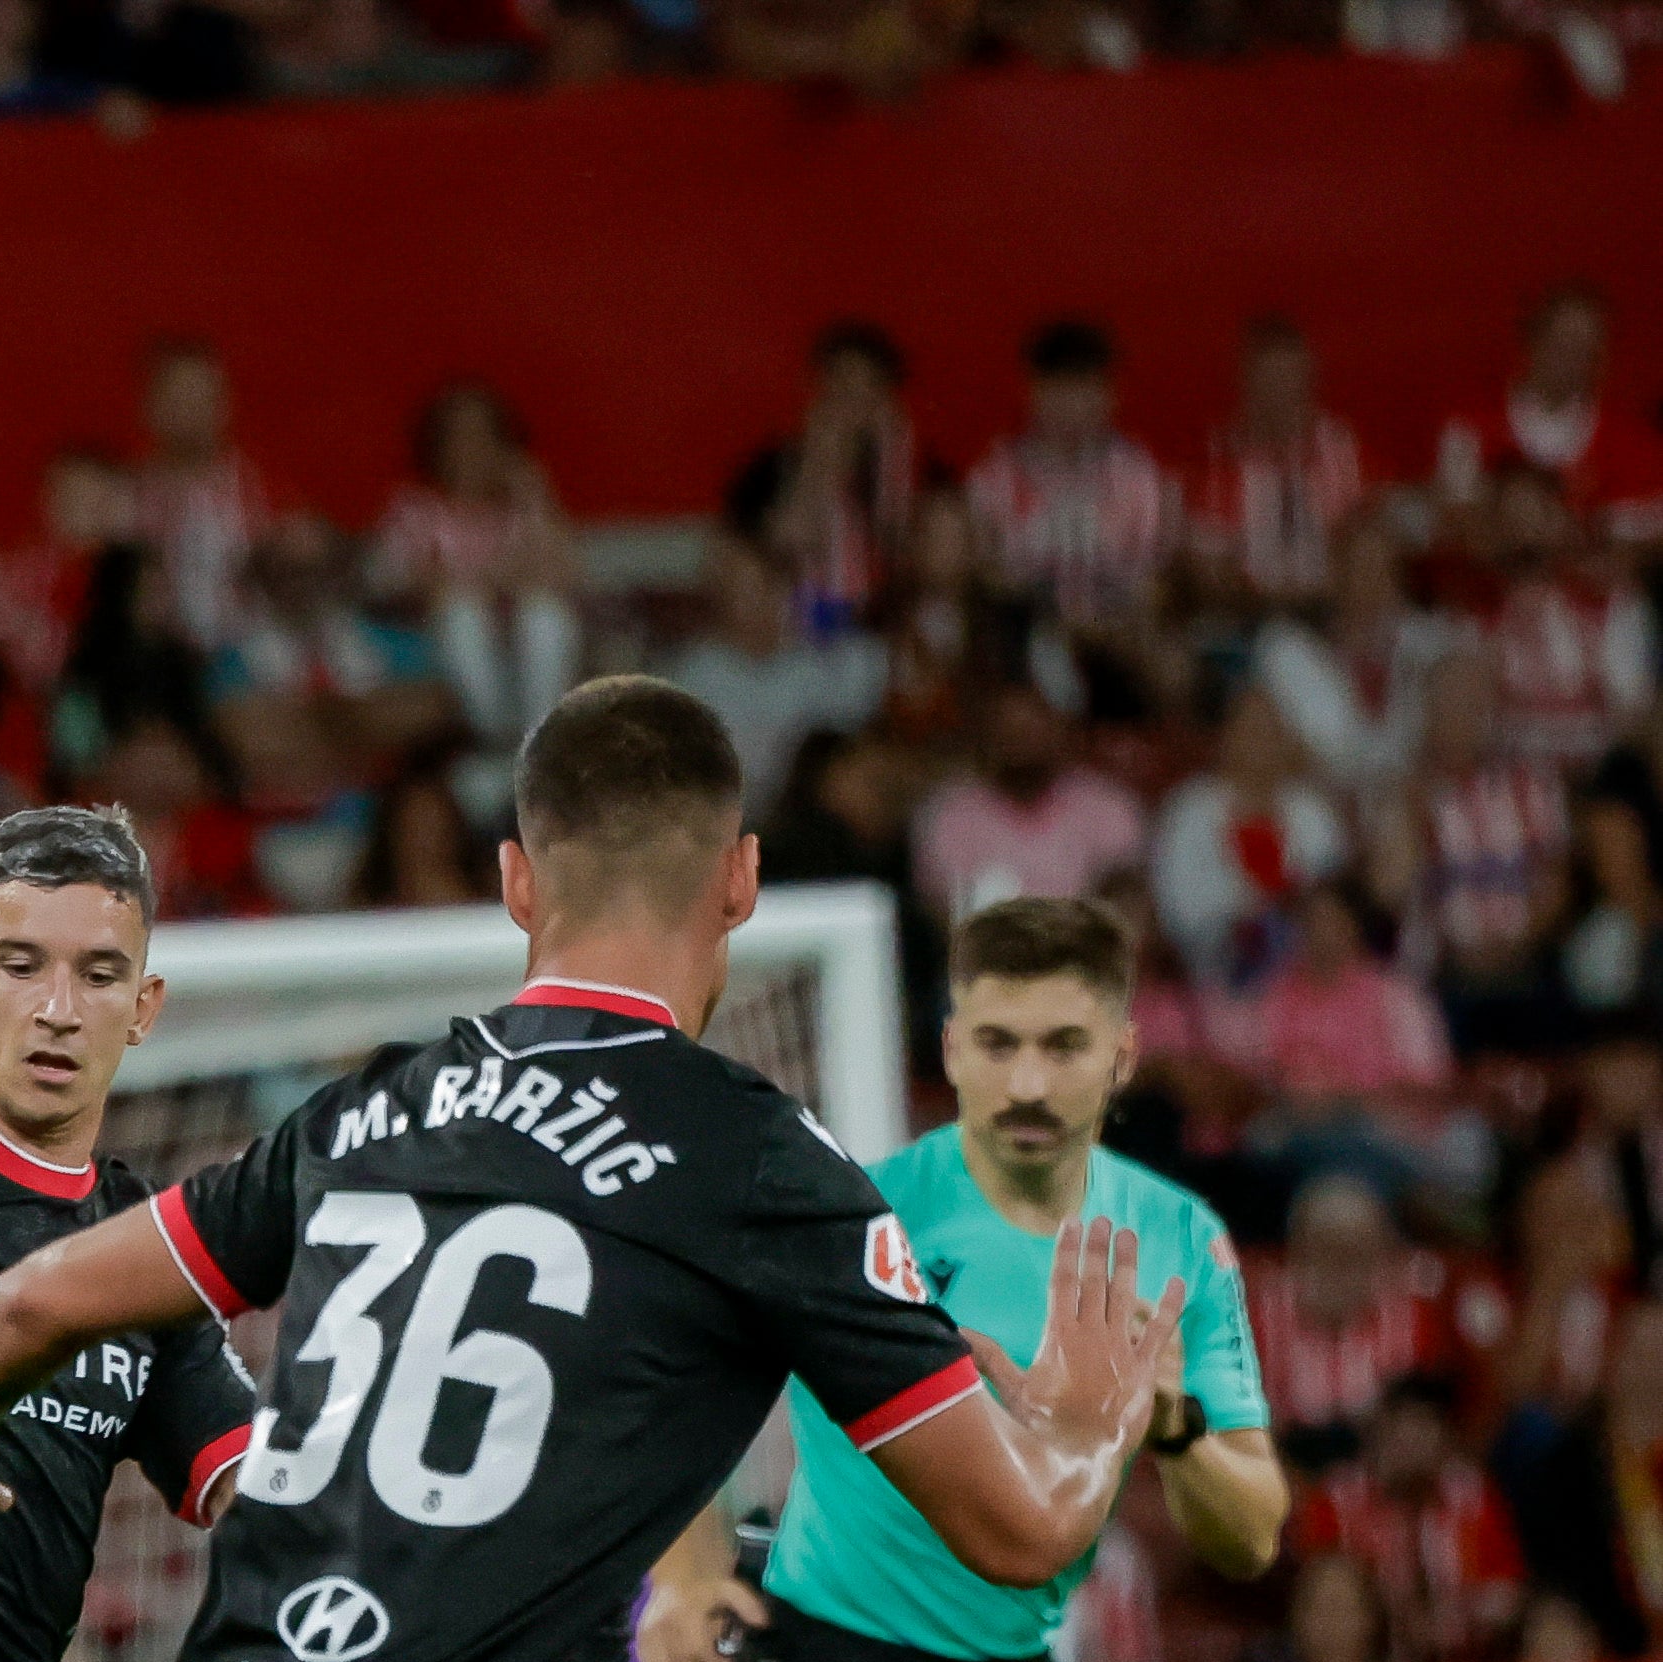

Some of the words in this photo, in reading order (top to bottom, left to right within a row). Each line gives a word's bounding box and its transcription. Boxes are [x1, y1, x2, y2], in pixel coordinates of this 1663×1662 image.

[330, 1090, 409, 1160] M.
[424, 1056, 677, 1197] BARŽIĆ
[235, 1190, 593, 1527] 36
